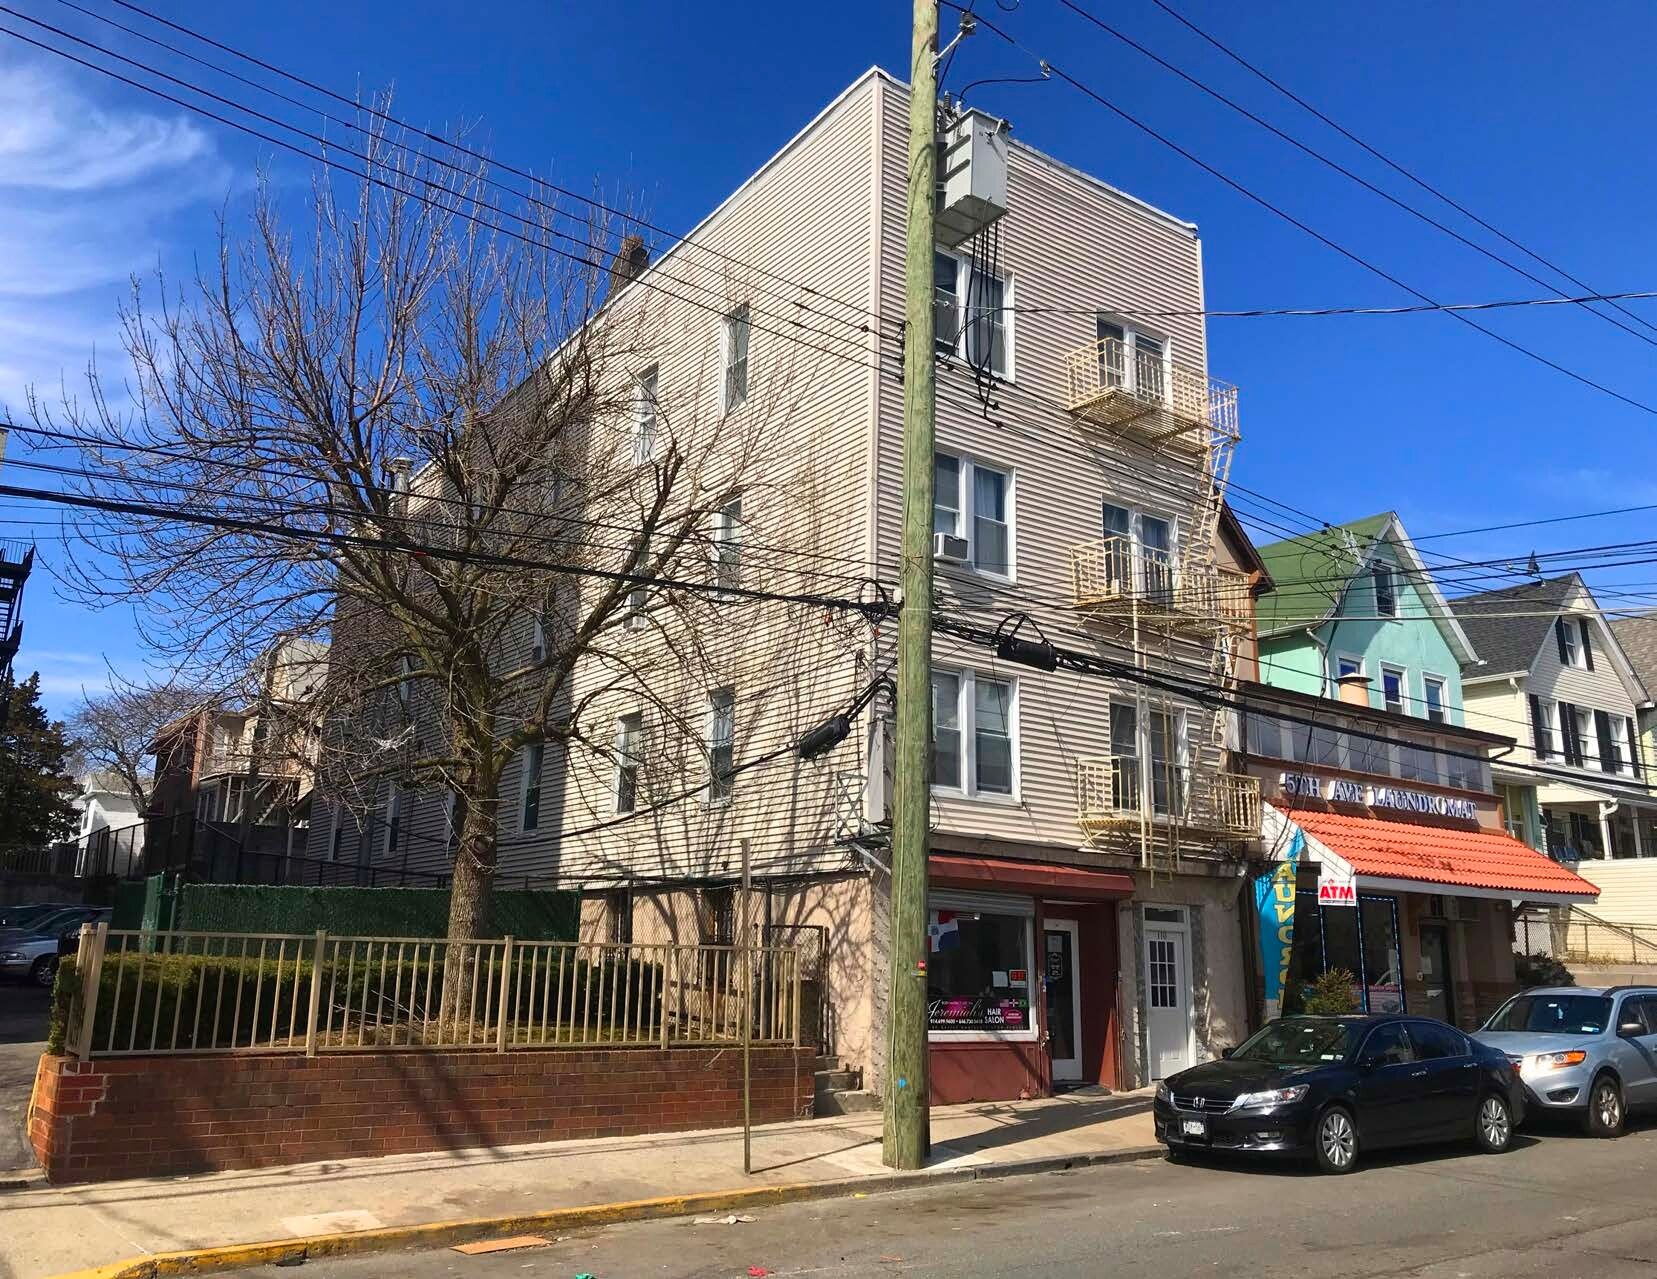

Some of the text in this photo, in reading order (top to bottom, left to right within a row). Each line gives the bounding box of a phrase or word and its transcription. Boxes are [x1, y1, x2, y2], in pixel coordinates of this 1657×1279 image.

[1281, 772, 1477, 820] 5TH AVE LAUNDROMAT
[1319, 885, 1354, 900] ATM
[987, 1008, 1002, 1016] HAIR
[984, 1016, 1005, 1024] SALON
